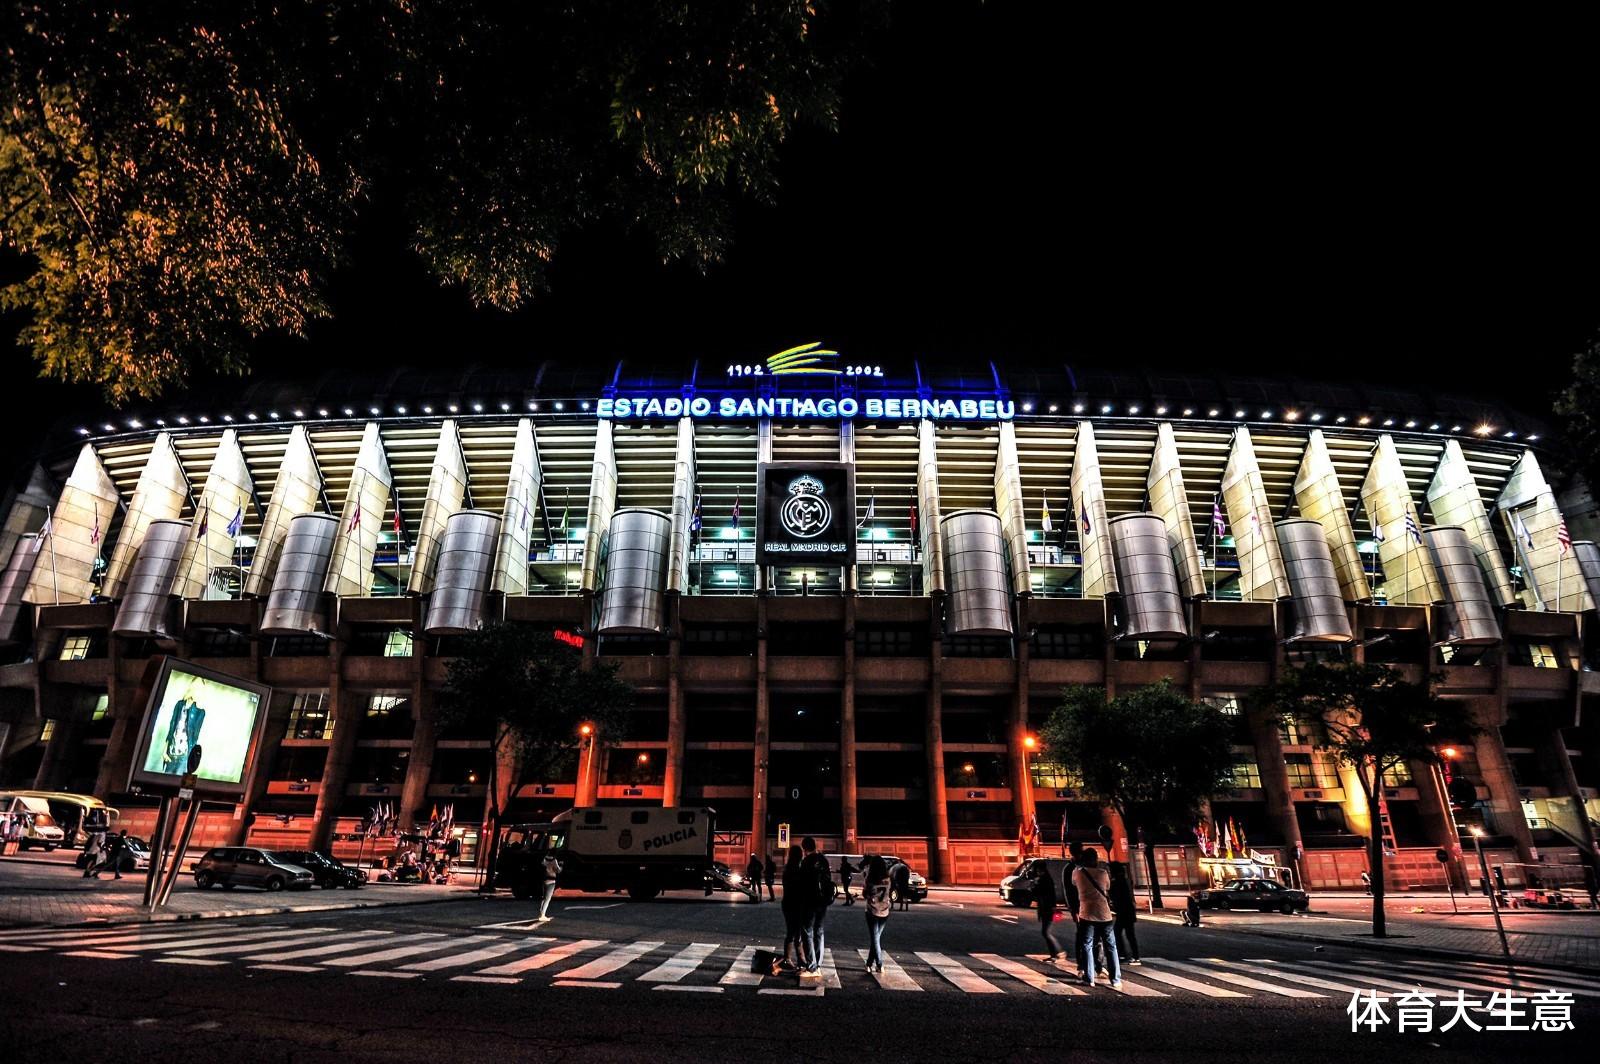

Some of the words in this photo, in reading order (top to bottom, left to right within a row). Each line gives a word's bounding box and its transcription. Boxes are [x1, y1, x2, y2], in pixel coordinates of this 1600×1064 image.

[727, 364, 764, 377] 1902
[845, 365, 883, 378] 2002
[596, 397, 711, 418] ESTADIO
[719, 397, 858, 419] SANTIAGO
[866, 398, 1015, 420] BERNABEU
[764, 543, 790, 552] REAL
[790, 543, 829, 552] MADRID
[643, 827, 697, 851] POLICIA
